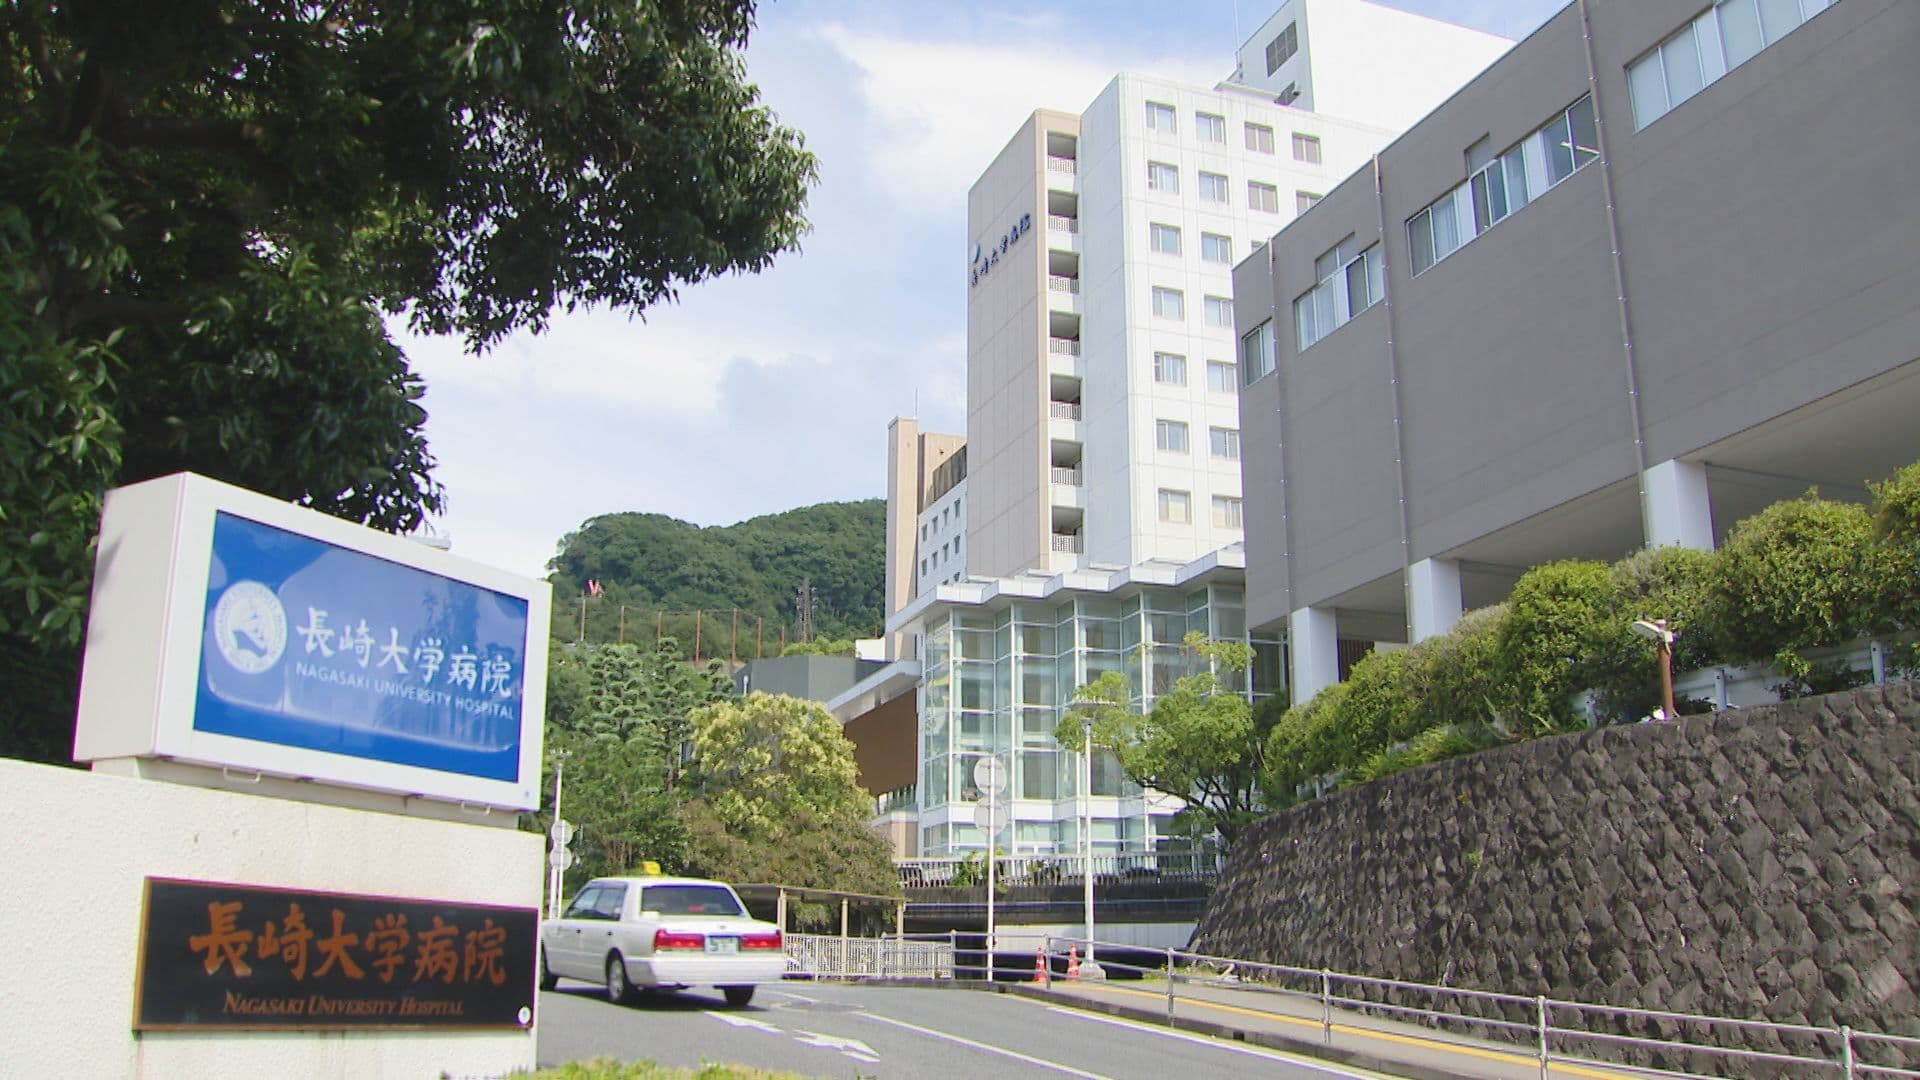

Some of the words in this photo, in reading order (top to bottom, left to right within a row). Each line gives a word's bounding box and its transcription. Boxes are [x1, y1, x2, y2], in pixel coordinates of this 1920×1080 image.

[296, 607, 513, 698] 長崎大学病院
[296, 662, 370, 689] NAGASAKI
[374, 679, 452, 706] UNIVERSITY
[455, 697, 514, 720] HOSPITAL
[188, 901, 507, 985] 長崎大学病院
[223, 990, 304, 1015] NAGASAKI
[308, 995, 396, 1017] UNIVERSITY
[399, 996, 465, 1017] HOSPITAL
